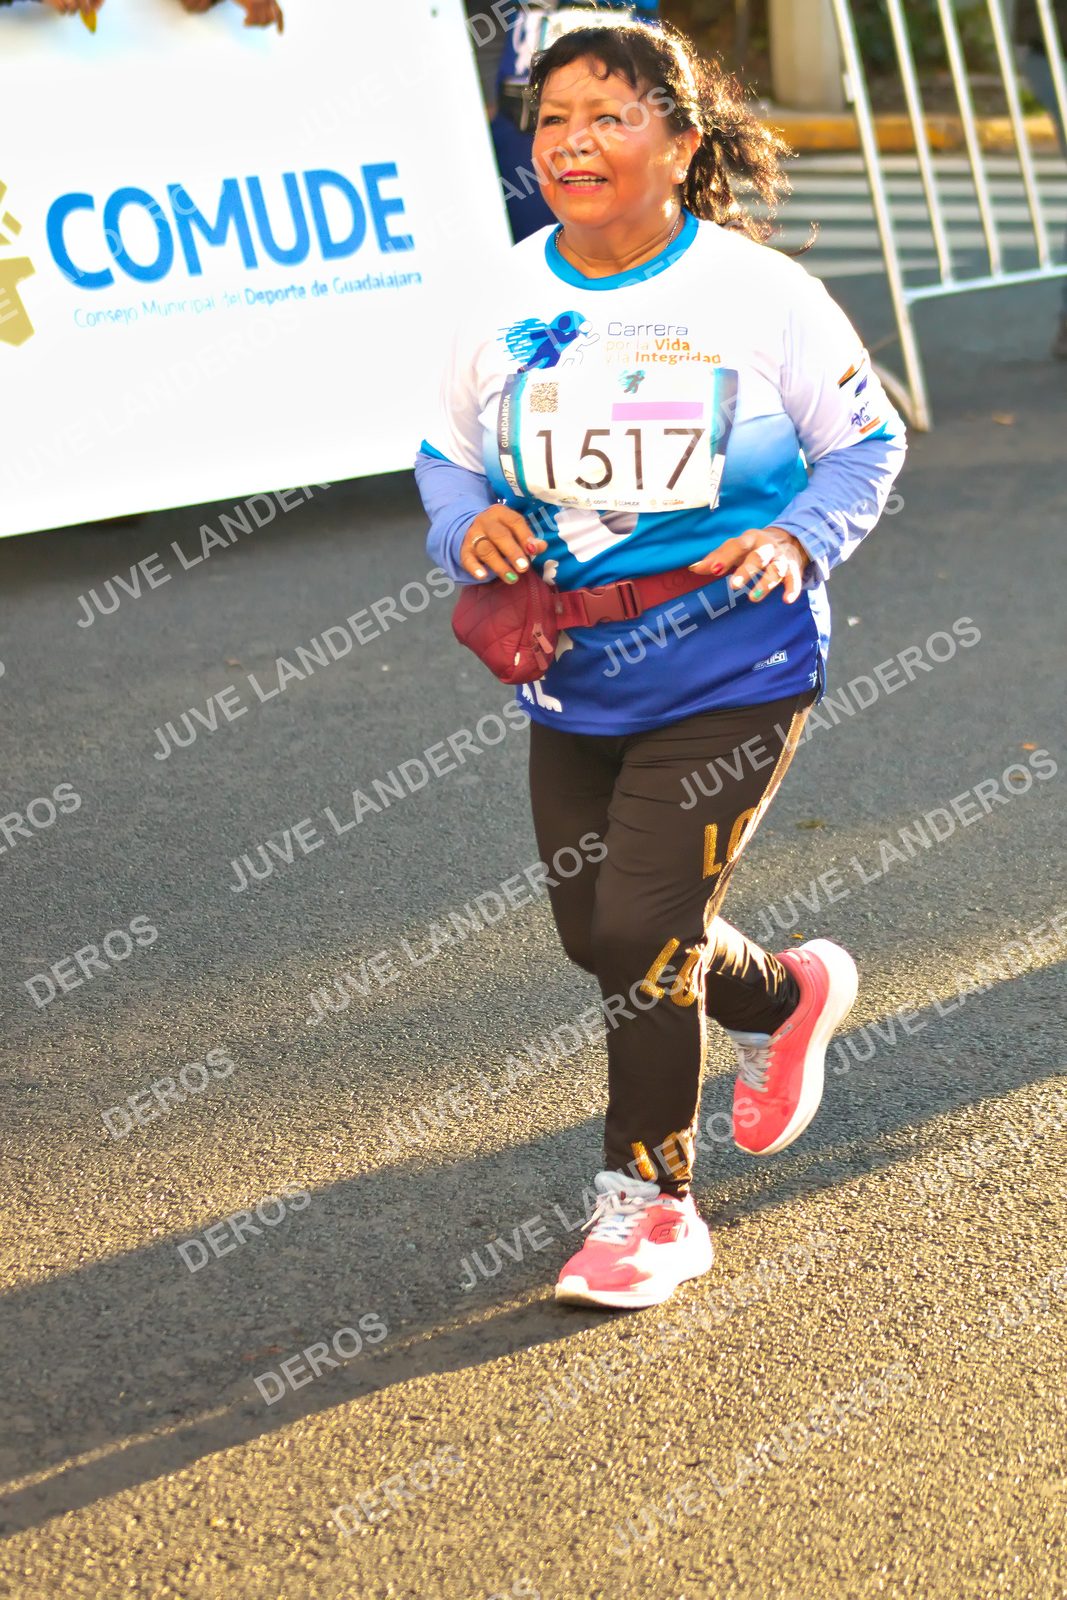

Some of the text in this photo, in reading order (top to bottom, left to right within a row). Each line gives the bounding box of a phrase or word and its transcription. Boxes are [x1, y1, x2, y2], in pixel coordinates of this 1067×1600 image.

[46, 161, 415, 291] COMUDE
[74, 307, 138, 327] Consejo
[244, 284, 307, 308] Deporte
[311, 280, 328, 297] de
[332, 271, 423, 296] Guadalajara
[608, 321, 689, 337] Carrera
[655, 338, 690, 351] Vida
[501, 393, 512, 448] GUARDARROPA
[536, 428, 706, 490] 1517
